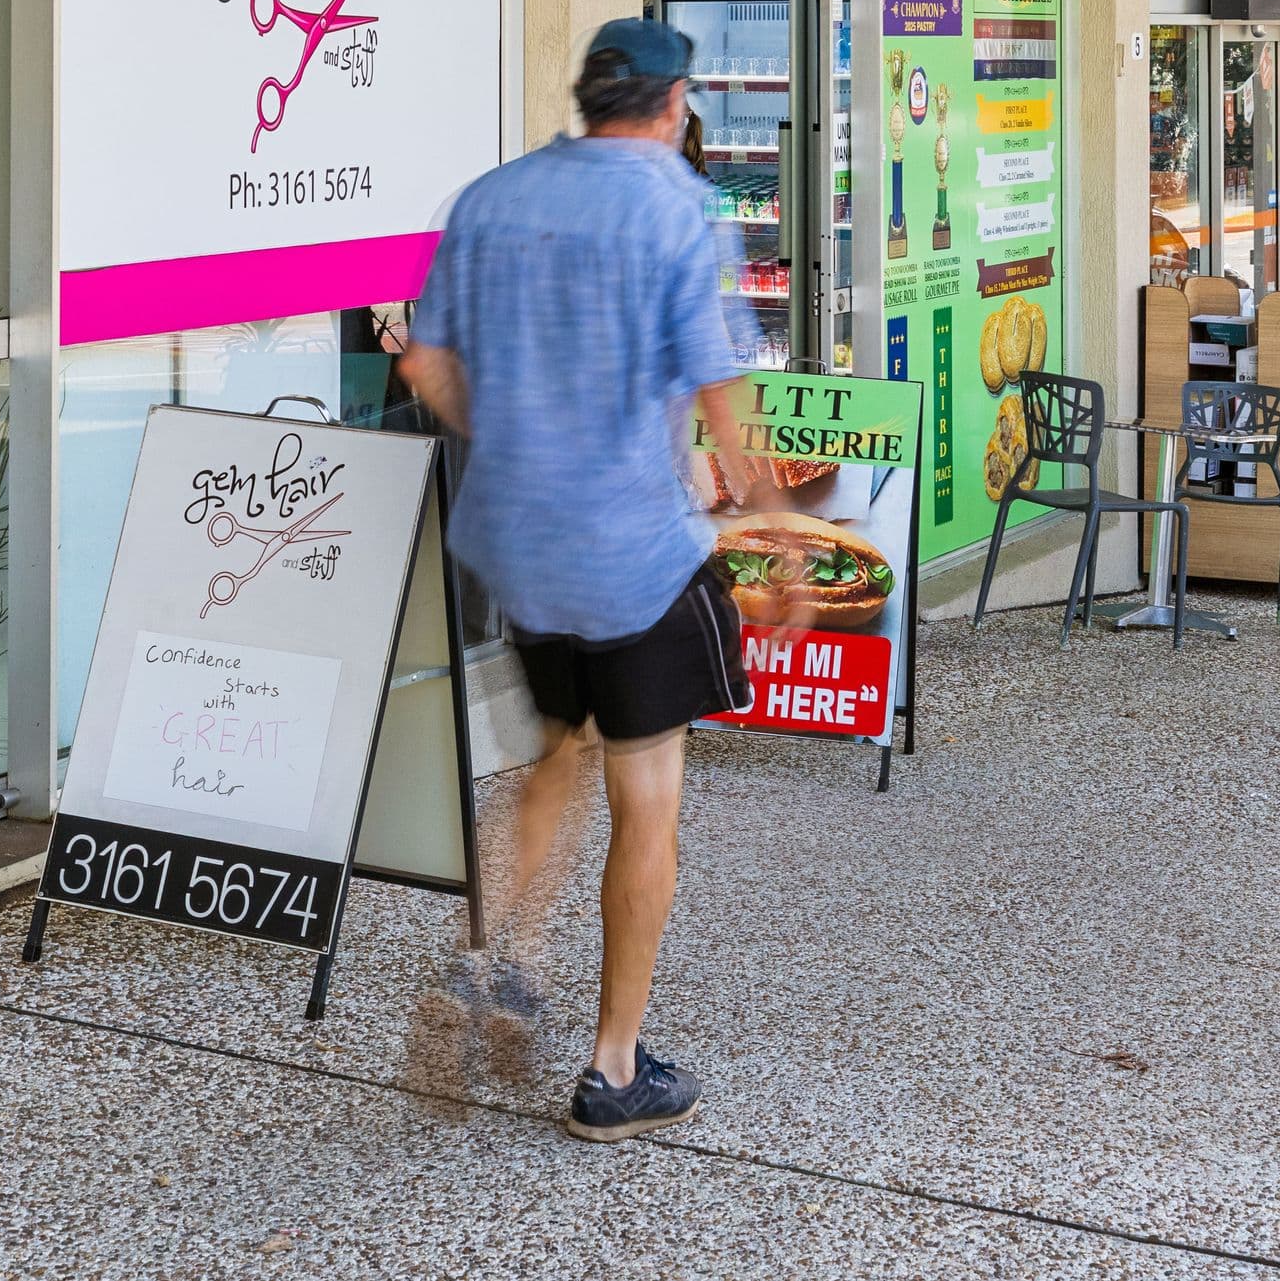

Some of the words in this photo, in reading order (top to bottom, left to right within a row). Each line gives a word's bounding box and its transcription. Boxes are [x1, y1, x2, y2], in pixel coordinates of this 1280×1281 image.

[901, 2, 939, 18] CHAMPION
[917, 21, 936, 32] PASTRY
[324, 46, 340, 67] and
[341, 28, 379, 88] stuff
[1134, 37, 1141, 57] 5
[229, 174, 263, 209] Ph:
[269, 171, 316, 206] 3161
[324, 166, 373, 202] 5674
[925, 282, 952, 298] GOURMET
[952, 280, 960, 295] PIE
[692, 419, 903, 462] PTISSERIE
[185, 464, 265, 524] gem
[265, 433, 345, 518] hair
[935, 465, 952, 483] PLACE
[282, 556, 299, 569] and
[300, 545, 342, 581] stuff
[145, 644, 242, 670] Confidence
[804, 642, 843, 680] MI
[203, 694, 236, 711] with
[161, 711, 289, 760] GREAT
[172, 756, 245, 797] hair
[58, 833, 171, 910] 3161
[185, 855, 318, 937] 5674
